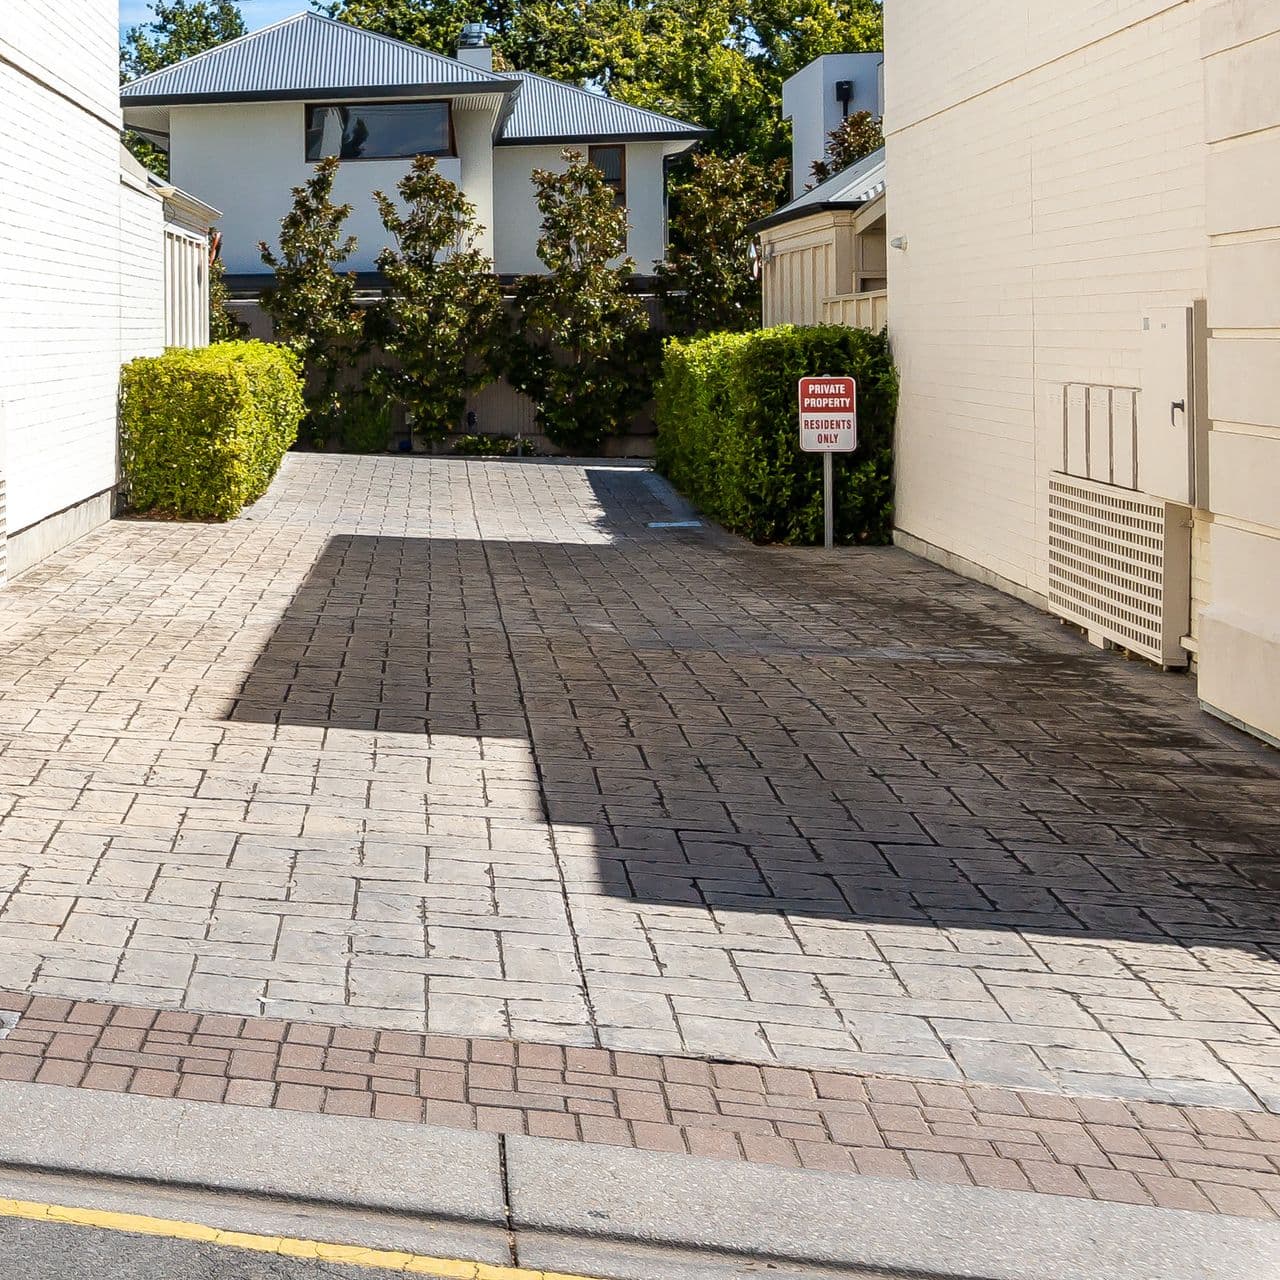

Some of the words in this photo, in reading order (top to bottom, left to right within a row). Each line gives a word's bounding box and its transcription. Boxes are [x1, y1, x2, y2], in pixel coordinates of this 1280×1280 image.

[808, 384, 846, 394] PRIVATE
[804, 398, 851, 408] PROPERTY
[804, 420, 852, 430] RESIDENTS
[817, 434, 839, 444] ONLY
